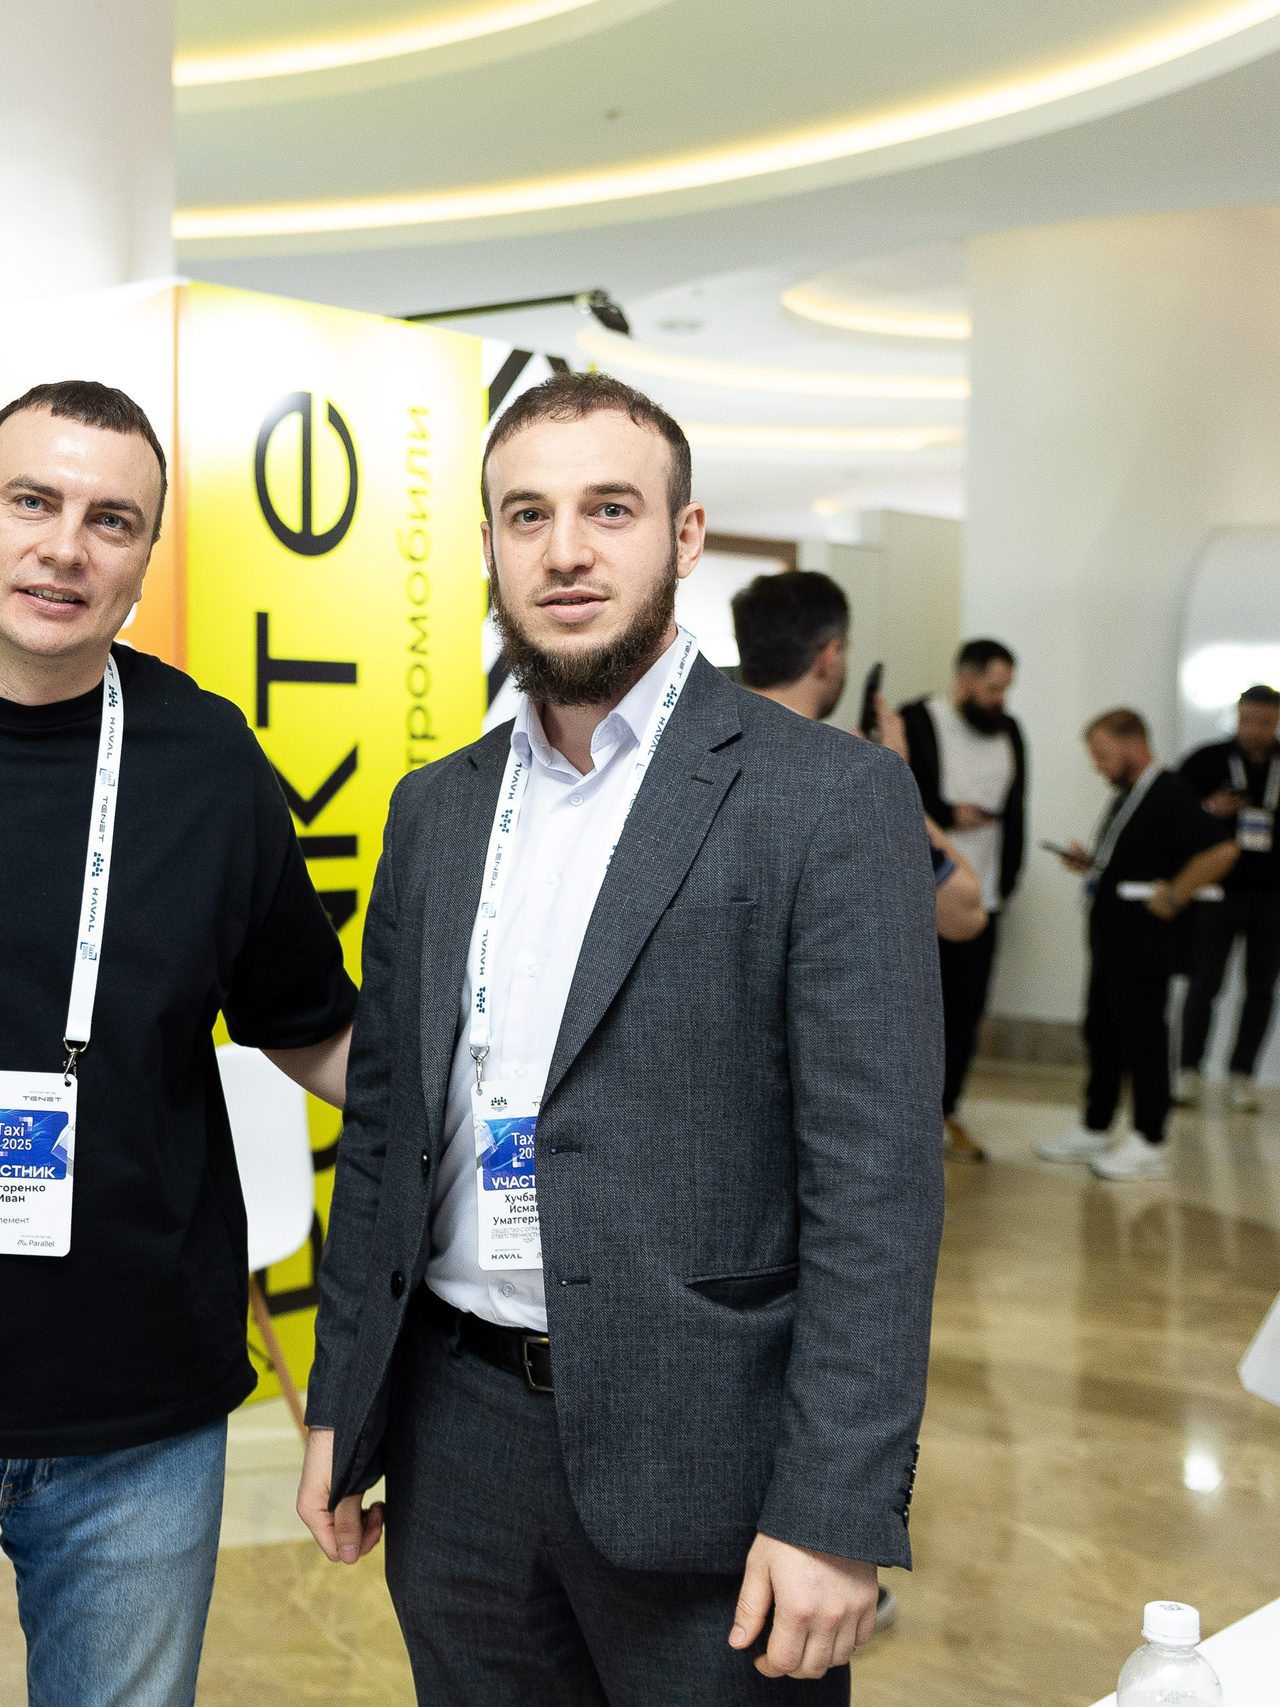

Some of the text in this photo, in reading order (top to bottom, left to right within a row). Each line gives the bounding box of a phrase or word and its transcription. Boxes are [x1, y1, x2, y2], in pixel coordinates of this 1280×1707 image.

[397, 404, 438, 772] тромобили
[107, 716, 116, 759] HAVAL
[98, 796, 108, 843] TENET
[490, 844, 503, 889] TENET
[88, 887, 99, 932] HAVAL
[479, 929, 488, 975] HAVAL
[22, 1095, 62, 1103] TENET
[2, 1138, 32, 1151] 2025
[511, 1132, 535, 1146] Tax
[491, 1175, 536, 1190] УЧАСТ
[505, 1192, 537, 1205] Хучба
[509, 1204, 538, 1214] Исма
[493, 1215, 540, 1226] Уматгери
[28, 1239, 55, 1248] Parallel
